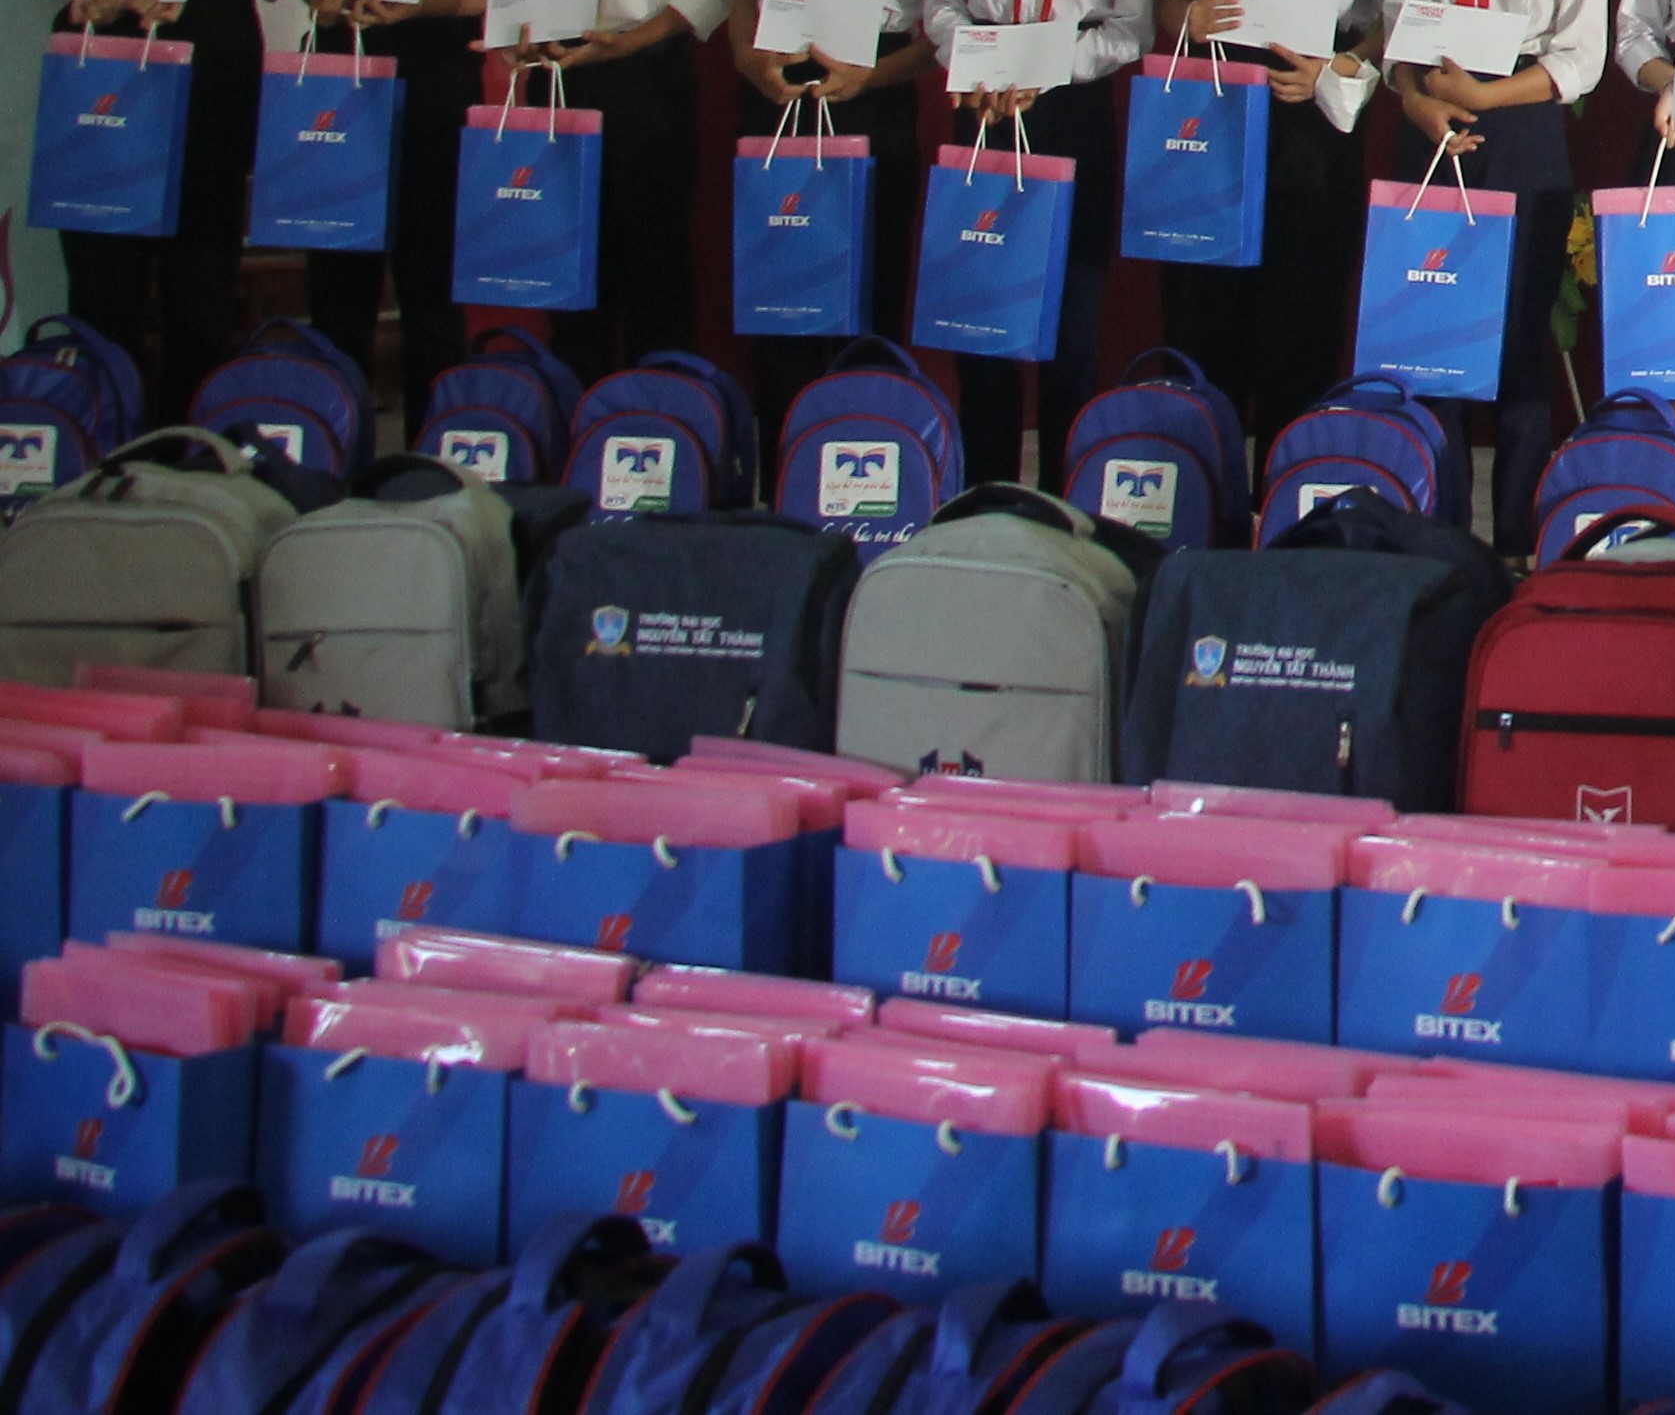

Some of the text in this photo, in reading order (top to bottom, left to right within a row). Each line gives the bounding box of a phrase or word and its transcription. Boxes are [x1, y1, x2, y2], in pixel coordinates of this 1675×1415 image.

[1166, 139, 1207, 152] BITEX
[496, 188, 541, 200] BITEX
[961, 230, 1004, 244] BITEX
[1407, 270, 1456, 284] BITEX
[135, 909, 213, 933] BITEX
[1144, 1000, 1233, 1026] BITEX
[1415, 1015, 1500, 1043] BITEX
[1121, 1272, 1216, 1303] BITEX
[1397, 1305, 1496, 1333] BITEX
